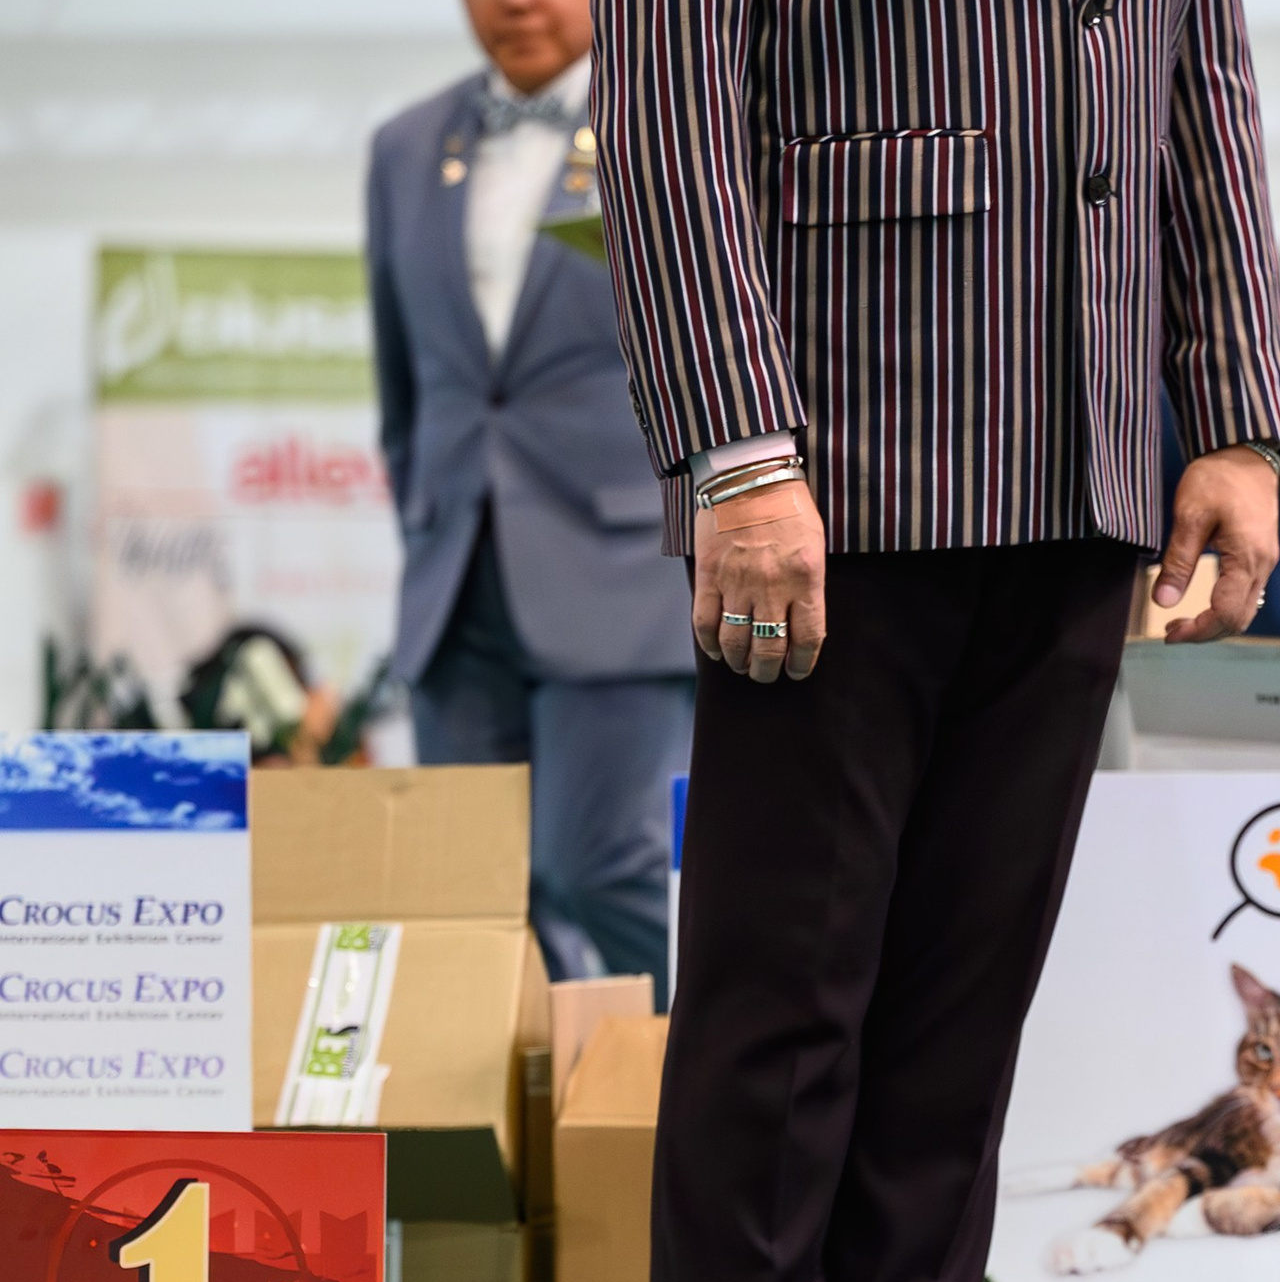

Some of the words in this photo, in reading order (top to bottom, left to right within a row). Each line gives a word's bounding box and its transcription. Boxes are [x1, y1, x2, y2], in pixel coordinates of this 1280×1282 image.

[0, 895, 123, 926] CROCUS
[133, 895, 224, 926] EXPO
[0, 972, 123, 1003] CROCUS
[133, 972, 224, 1003] EXPO
[133, 1049, 224, 1080] EXPO
